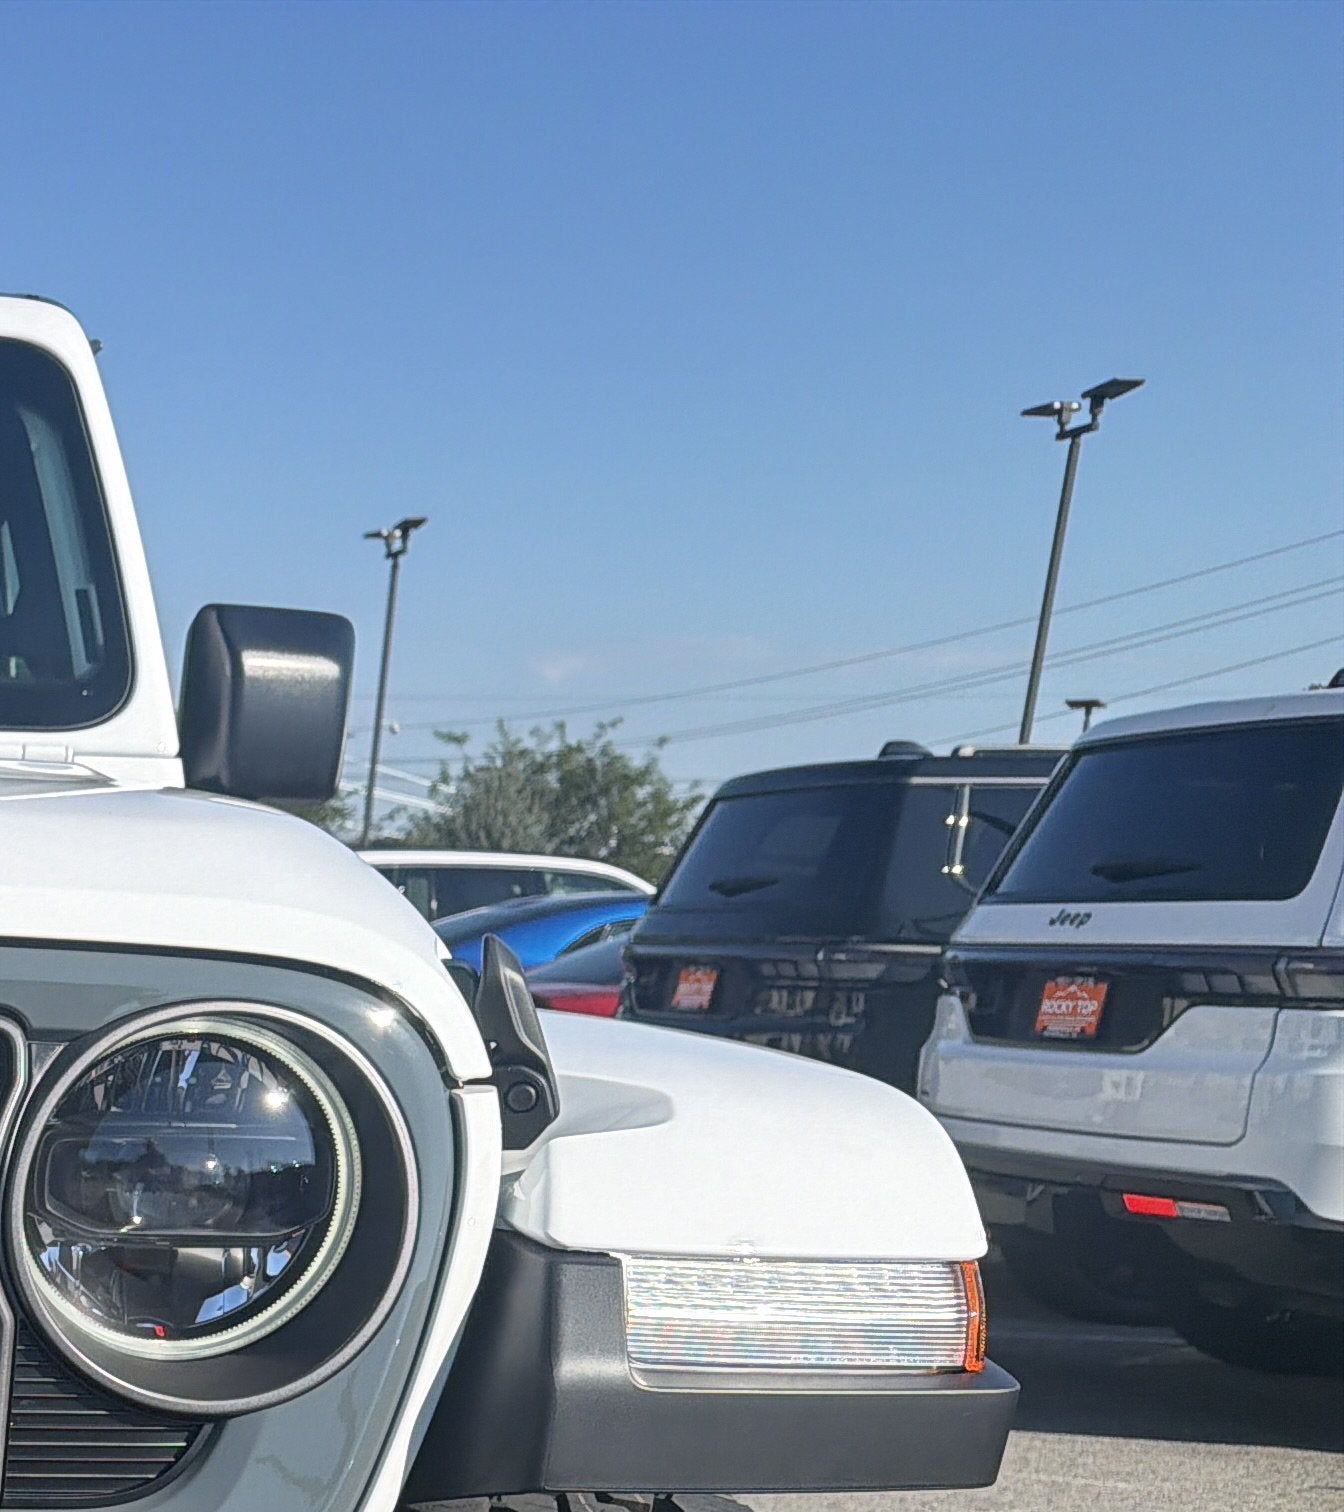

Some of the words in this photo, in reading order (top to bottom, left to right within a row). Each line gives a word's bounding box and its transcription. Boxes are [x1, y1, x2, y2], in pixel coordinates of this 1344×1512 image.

[1048, 908, 1093, 929] Jeep
[1040, 998, 1074, 1014] ROCKY
[1077, 999, 1099, 1015] TOP
